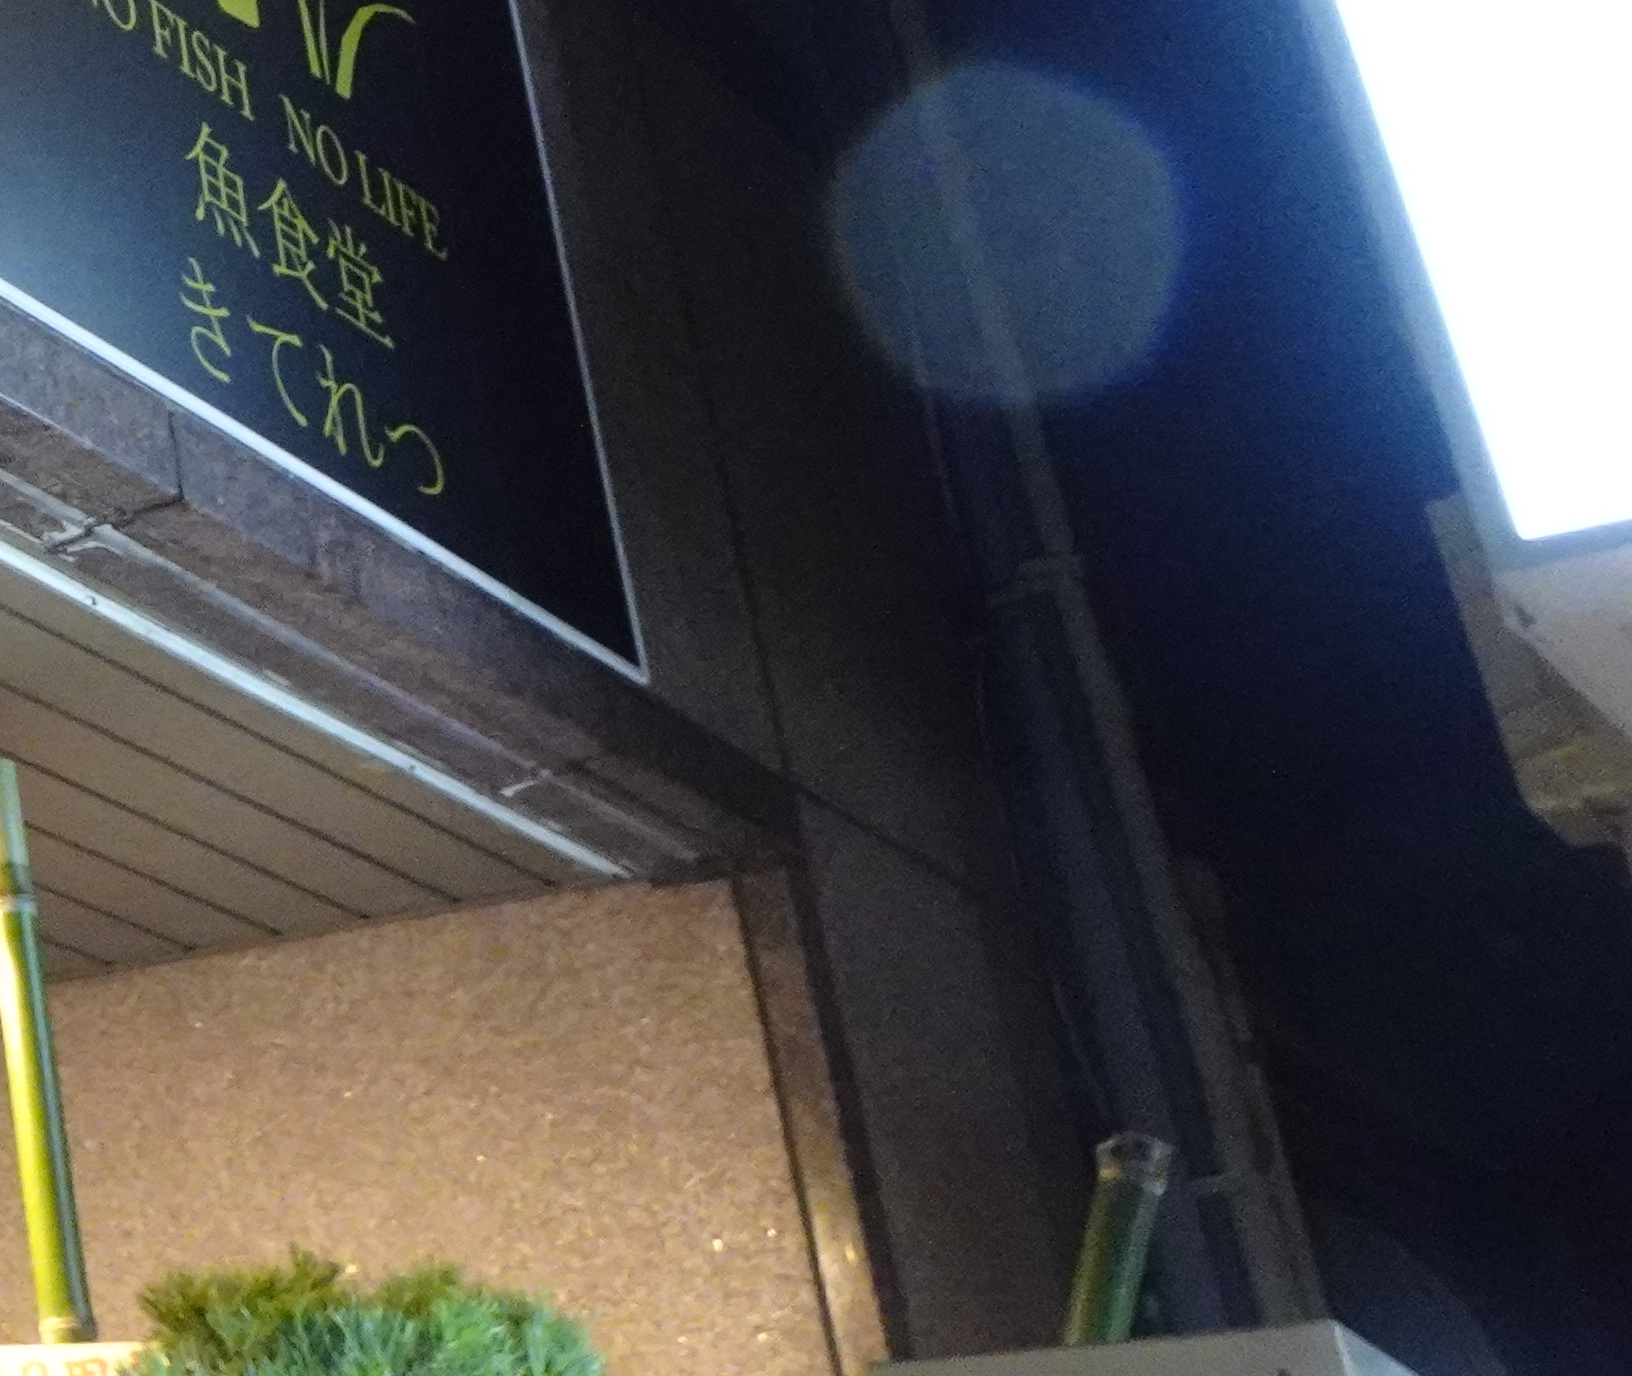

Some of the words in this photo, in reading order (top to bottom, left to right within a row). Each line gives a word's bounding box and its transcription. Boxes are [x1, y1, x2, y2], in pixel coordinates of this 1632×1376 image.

[185, 122, 396, 350] 魚食堂
[279, 94, 350, 187] NO
[355, 150, 449, 261] LIFE
[180, 257, 446, 496] きてれつ
